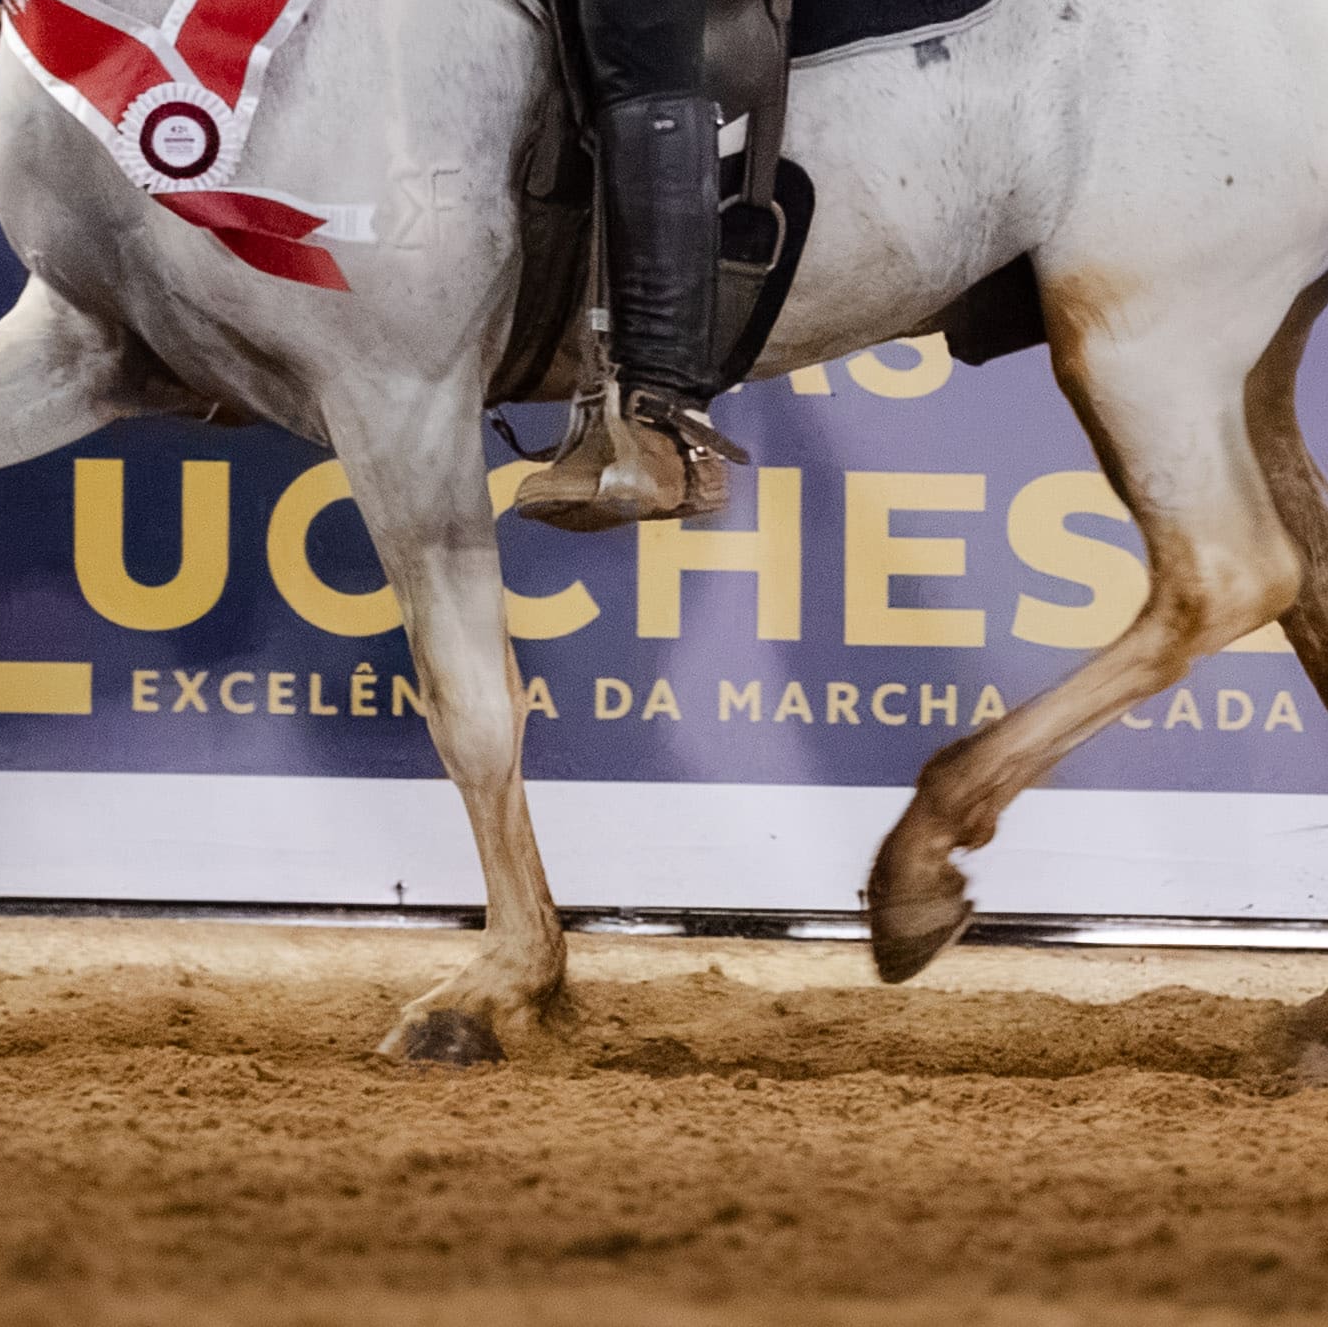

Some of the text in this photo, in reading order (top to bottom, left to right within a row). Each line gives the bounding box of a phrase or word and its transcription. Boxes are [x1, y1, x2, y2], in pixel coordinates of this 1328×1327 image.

[130, 661, 1305, 734] EXCELÊNA DA MARCHA ADA
